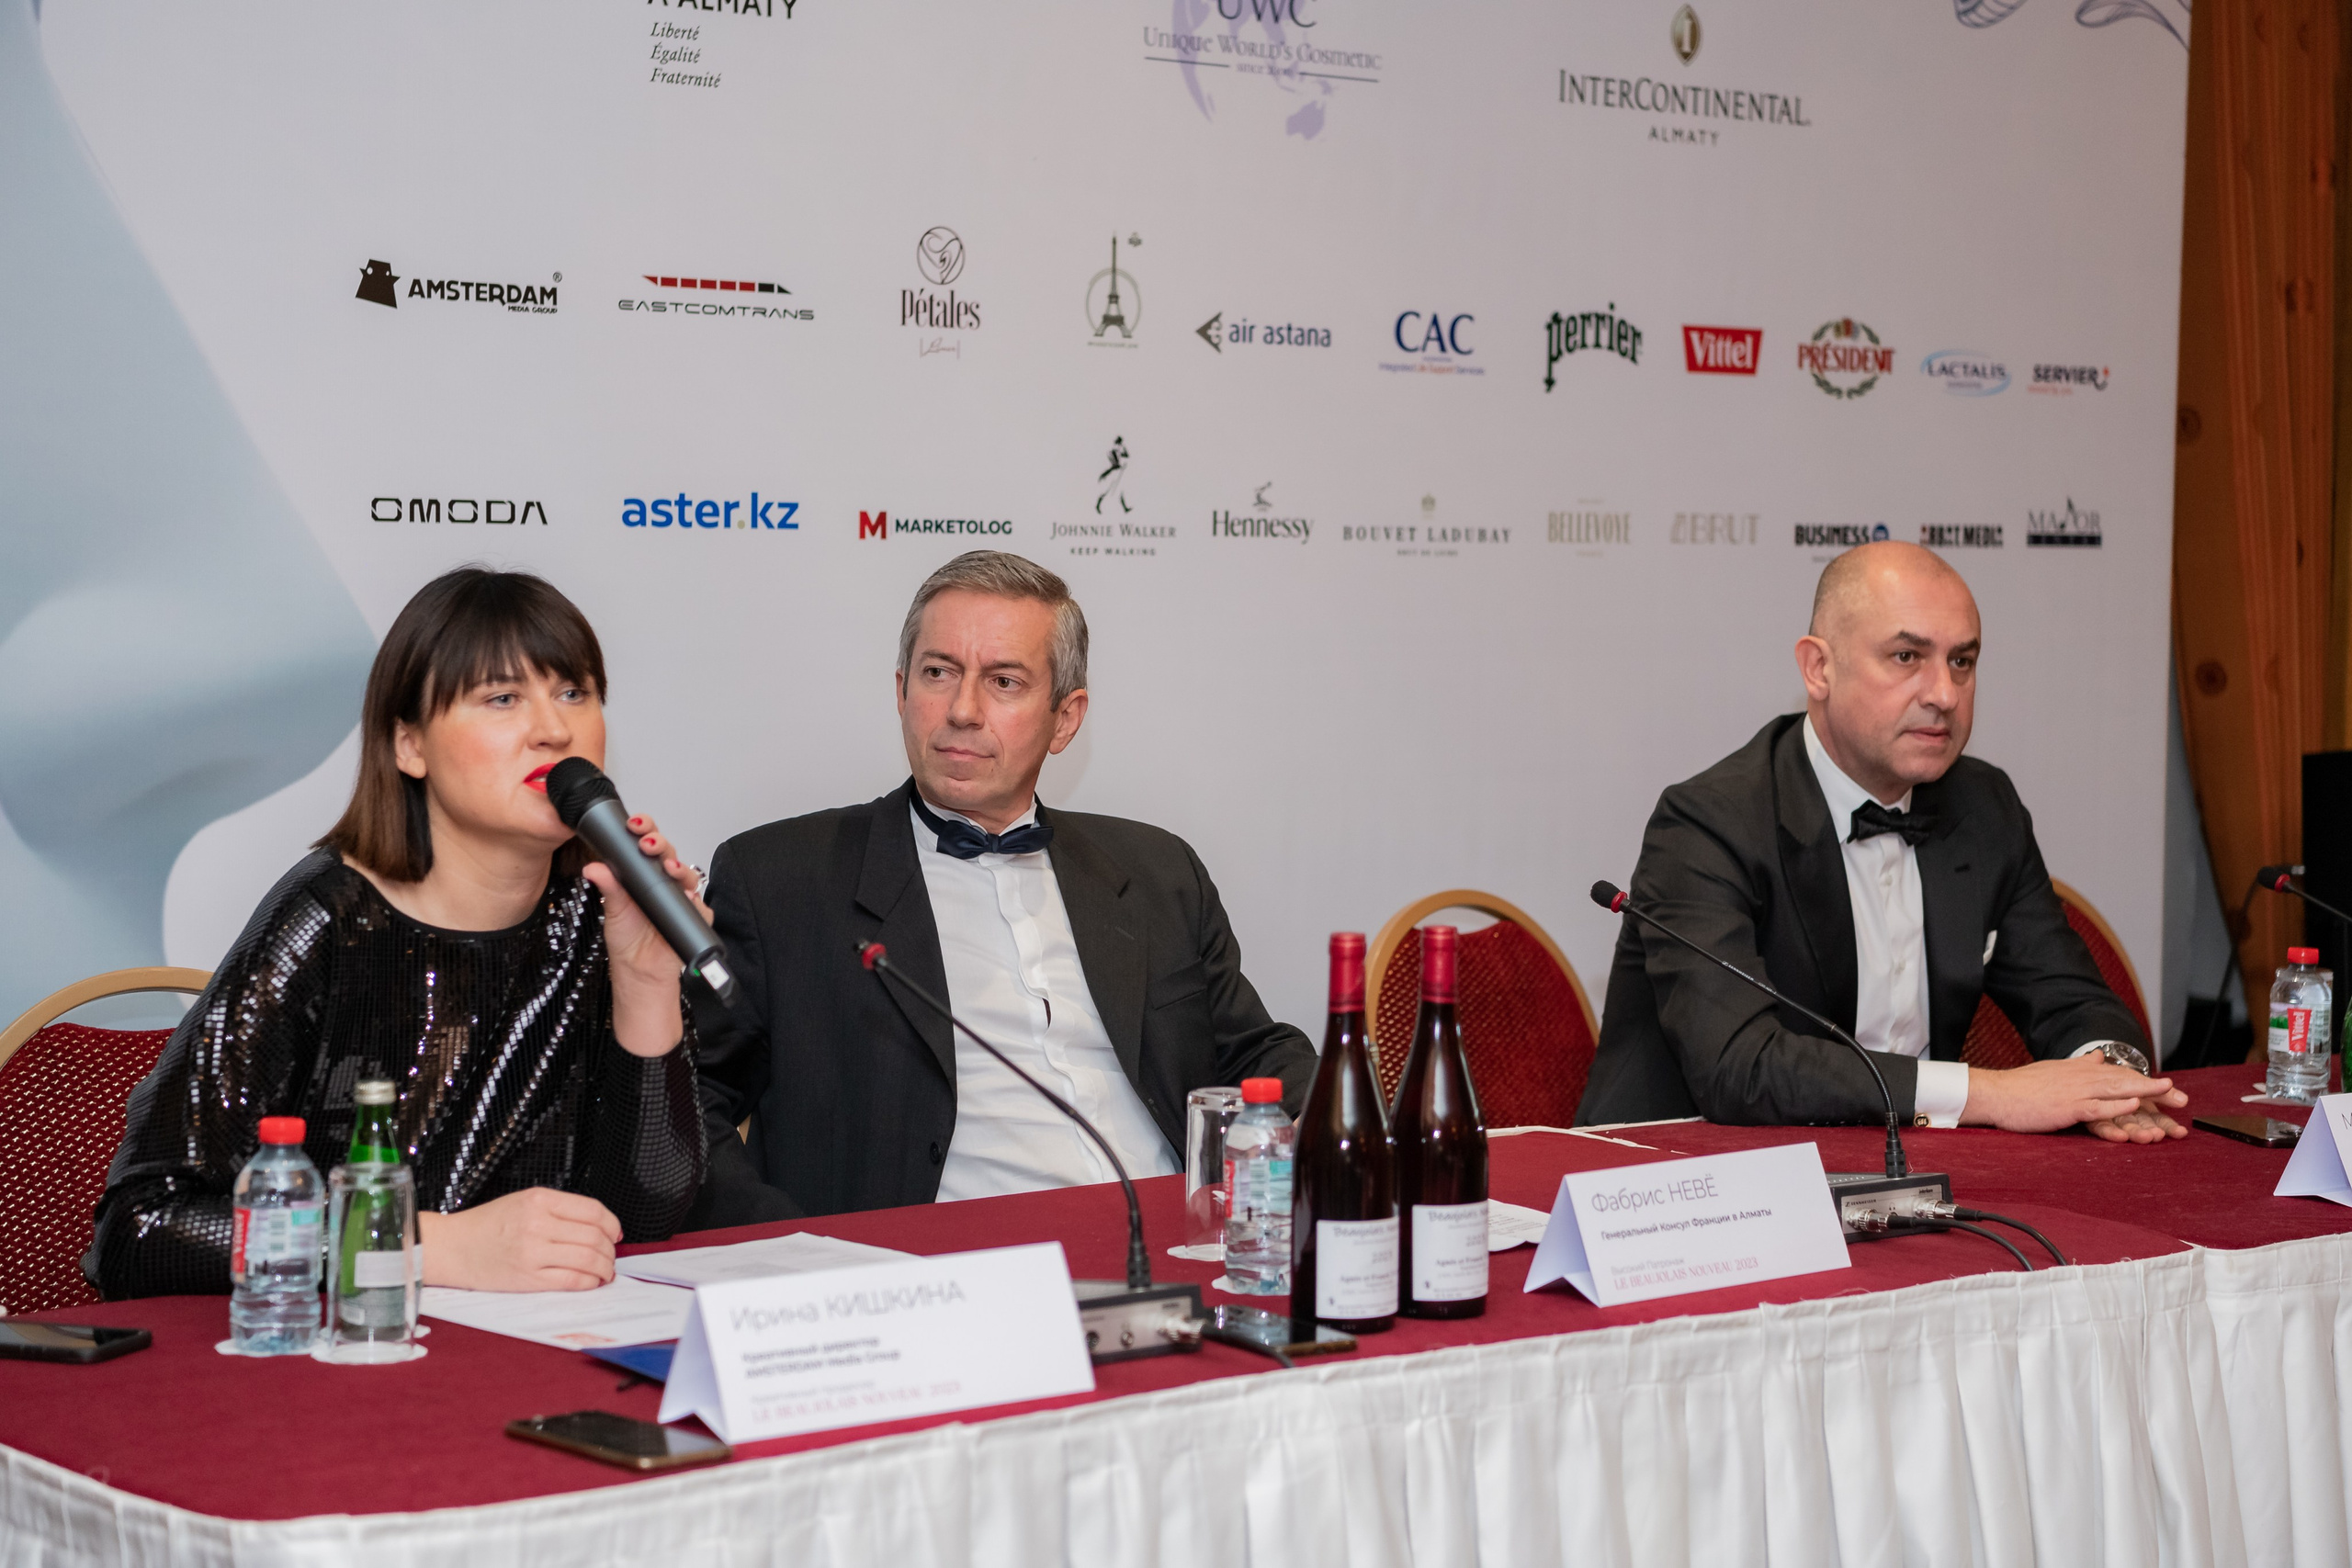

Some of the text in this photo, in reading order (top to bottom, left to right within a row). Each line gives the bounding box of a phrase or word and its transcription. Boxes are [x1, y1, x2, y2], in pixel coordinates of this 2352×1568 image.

[650, 22, 701, 40] Liberté
[650, 41, 701, 64] Égalité
[650, 67, 722, 88] Fraternité
[1648, 125, 1720, 147] ALMATY
[408, 278, 558, 307] AMSTERDAM
[507, 304, 558, 315] MEDIA GROUP
[617, 299, 815, 321] EASTCOMTRANS
[900, 288, 981, 331] Pétales
[1228, 318, 1331, 347] air astana
[1394, 310, 1475, 355] CAC
[1689, 331, 1754, 368] Vittel
[1797, 339, 1895, 374] PRÉSIDENT
[1927, 360, 2007, 379] LACTALIS
[2032, 362, 2105, 389] SERVIER
[370, 497, 548, 525] OMODA
[621, 492, 799, 530] aster.kz
[895, 518, 1012, 536] MARKETOLOG
[1212, 510, 1312, 545] Hennessy
[1343, 525, 1512, 544] BOUVET LADUBAY
[1795, 524, 1870, 546] BUSINESS
[1591, 1174, 1719, 1213] Фабрис НЕВЁ
[1601, 1224, 1658, 1240] Генеральный
[1660, 1220, 1690, 1232] Консул
[1692, 1214, 1731, 1228] Франции
[1739, 1208, 1772, 1220] Алматы
[729, 1280, 966, 1332] Ирина КИШКИНА
